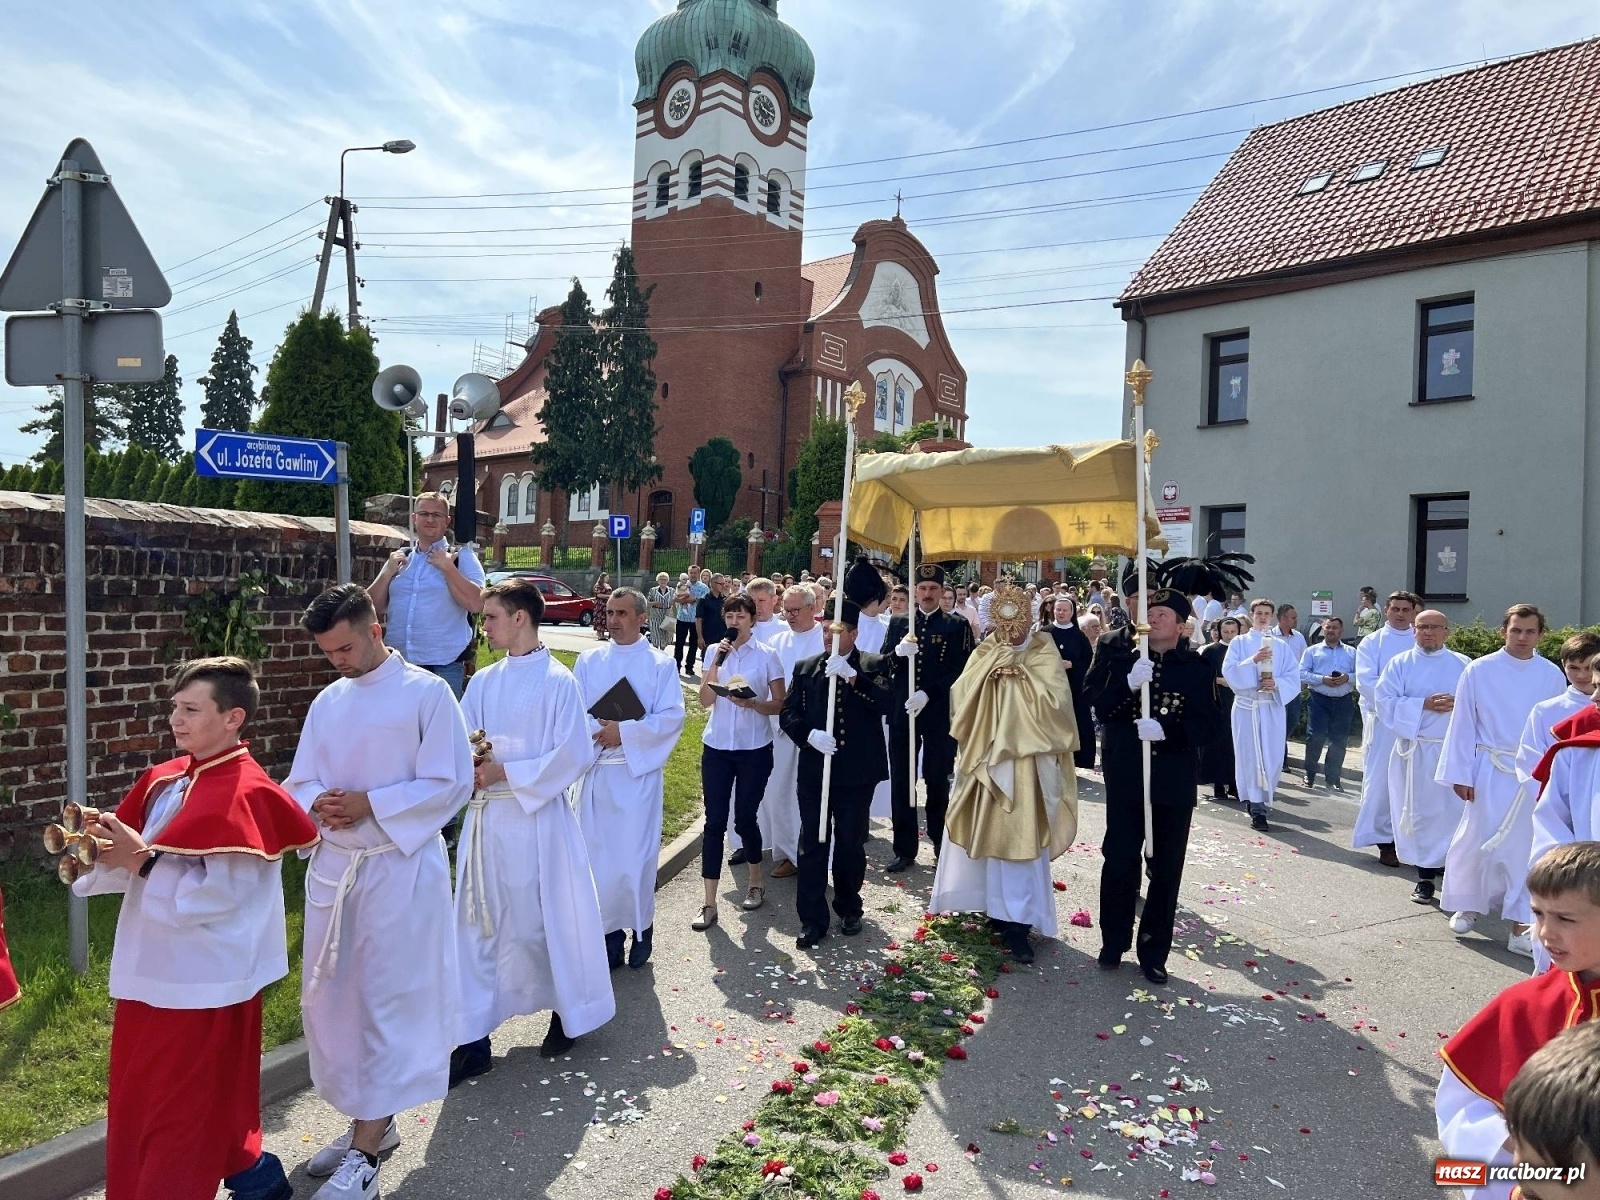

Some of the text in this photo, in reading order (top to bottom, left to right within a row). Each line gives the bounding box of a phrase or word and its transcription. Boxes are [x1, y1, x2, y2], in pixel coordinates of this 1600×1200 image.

[247, 441, 281, 453] arcybiskupa
[217, 448, 319, 478] ul. Józefa Gawliny
[694, 511, 702, 525] P
[614, 518, 626, 535] P
